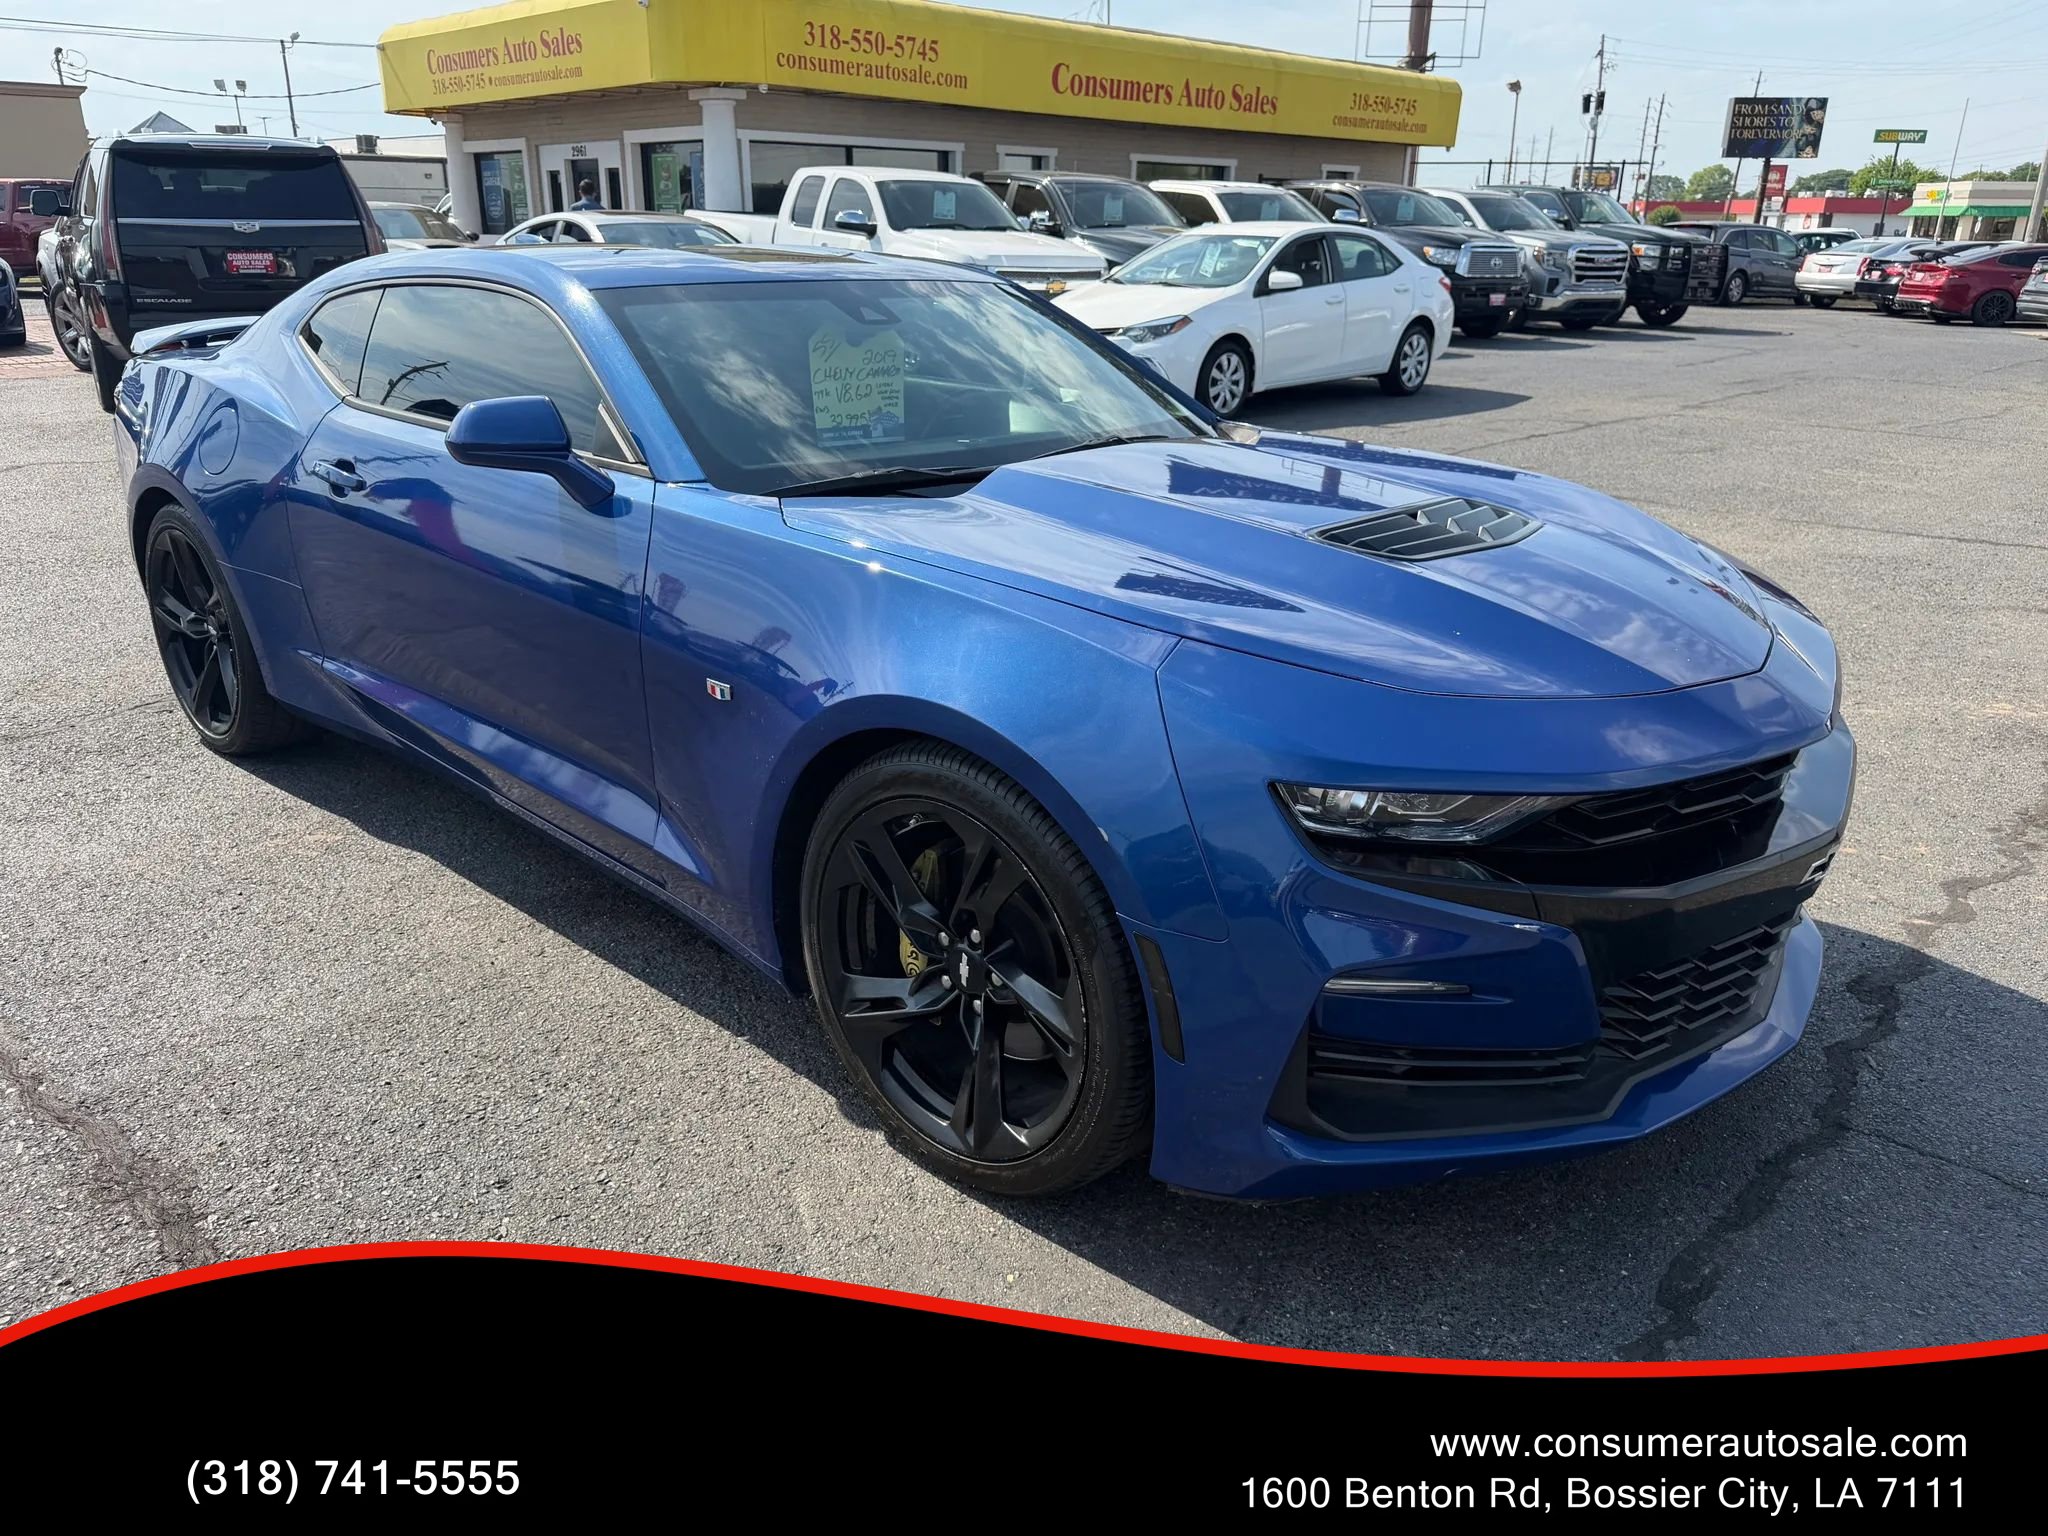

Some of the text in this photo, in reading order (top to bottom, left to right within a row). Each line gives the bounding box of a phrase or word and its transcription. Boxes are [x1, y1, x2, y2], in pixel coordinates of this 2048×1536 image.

[427, 27, 583, 75] Consumers Auto Sales
[803, 21, 940, 63] 318-550-5745
[432, 64, 583, 95] 318-550-5745 consumerautosale.com
[776, 52, 968, 90] consumerautosale.com
[1051, 62, 1278, 116] Consumers Auto Sales
[1350, 92, 1417, 117] 318-550-5745
[1734, 103, 1807, 115] FROM SANDY
[1332, 115, 1428, 134] consumerautosale.com
[1732, 116, 1796, 127] SHORES TO
[1878, 132, 1925, 141] SUBWAY
[571, 145, 587, 158] 2961
[227, 252, 274, 261] CONSUMERS
[862, 348, 897, 366] 2019
